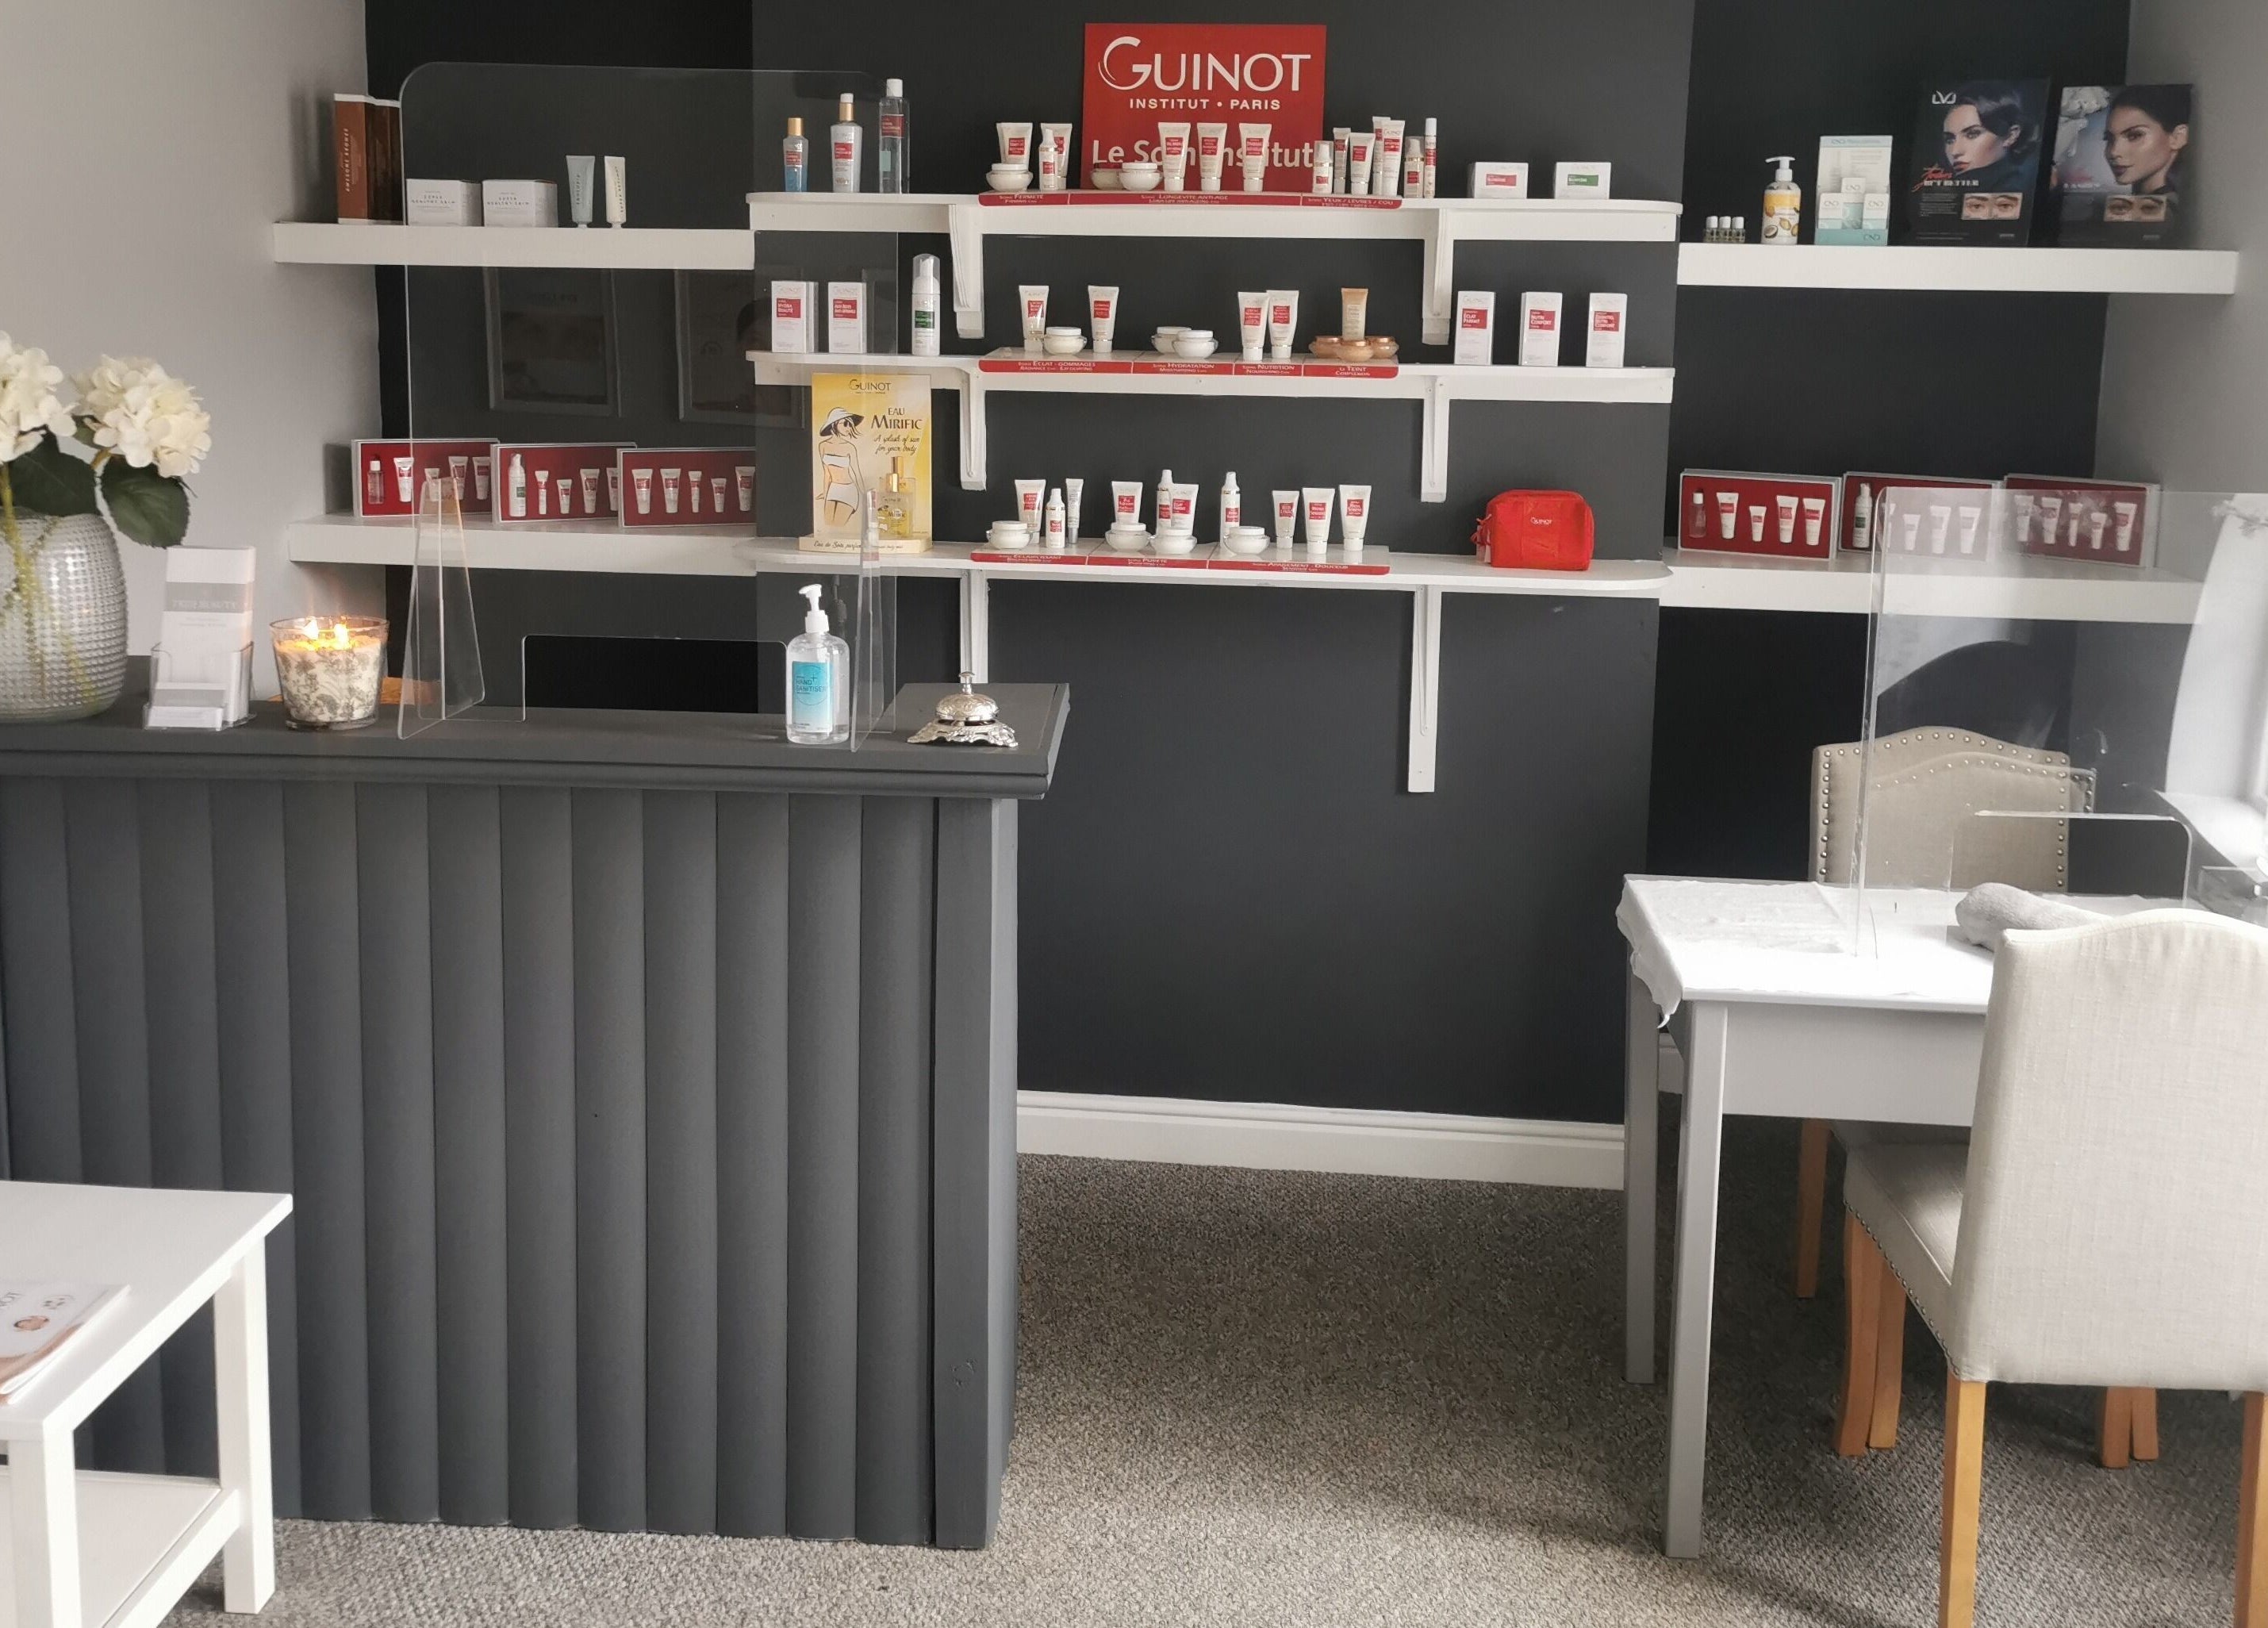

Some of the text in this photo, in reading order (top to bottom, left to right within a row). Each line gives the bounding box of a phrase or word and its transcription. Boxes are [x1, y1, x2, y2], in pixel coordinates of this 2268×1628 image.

[1098, 36, 1311, 92] GUINOT
[1130, 98, 1281, 110] INSTITUT PARIS
[1092, 140, 1125, 165] Le
[1133, 140, 1195, 166] Son
[849, 378, 892, 391] GUINOT
[888, 406, 905, 416] EAU
[871, 413, 923, 430] MIRIFIC
